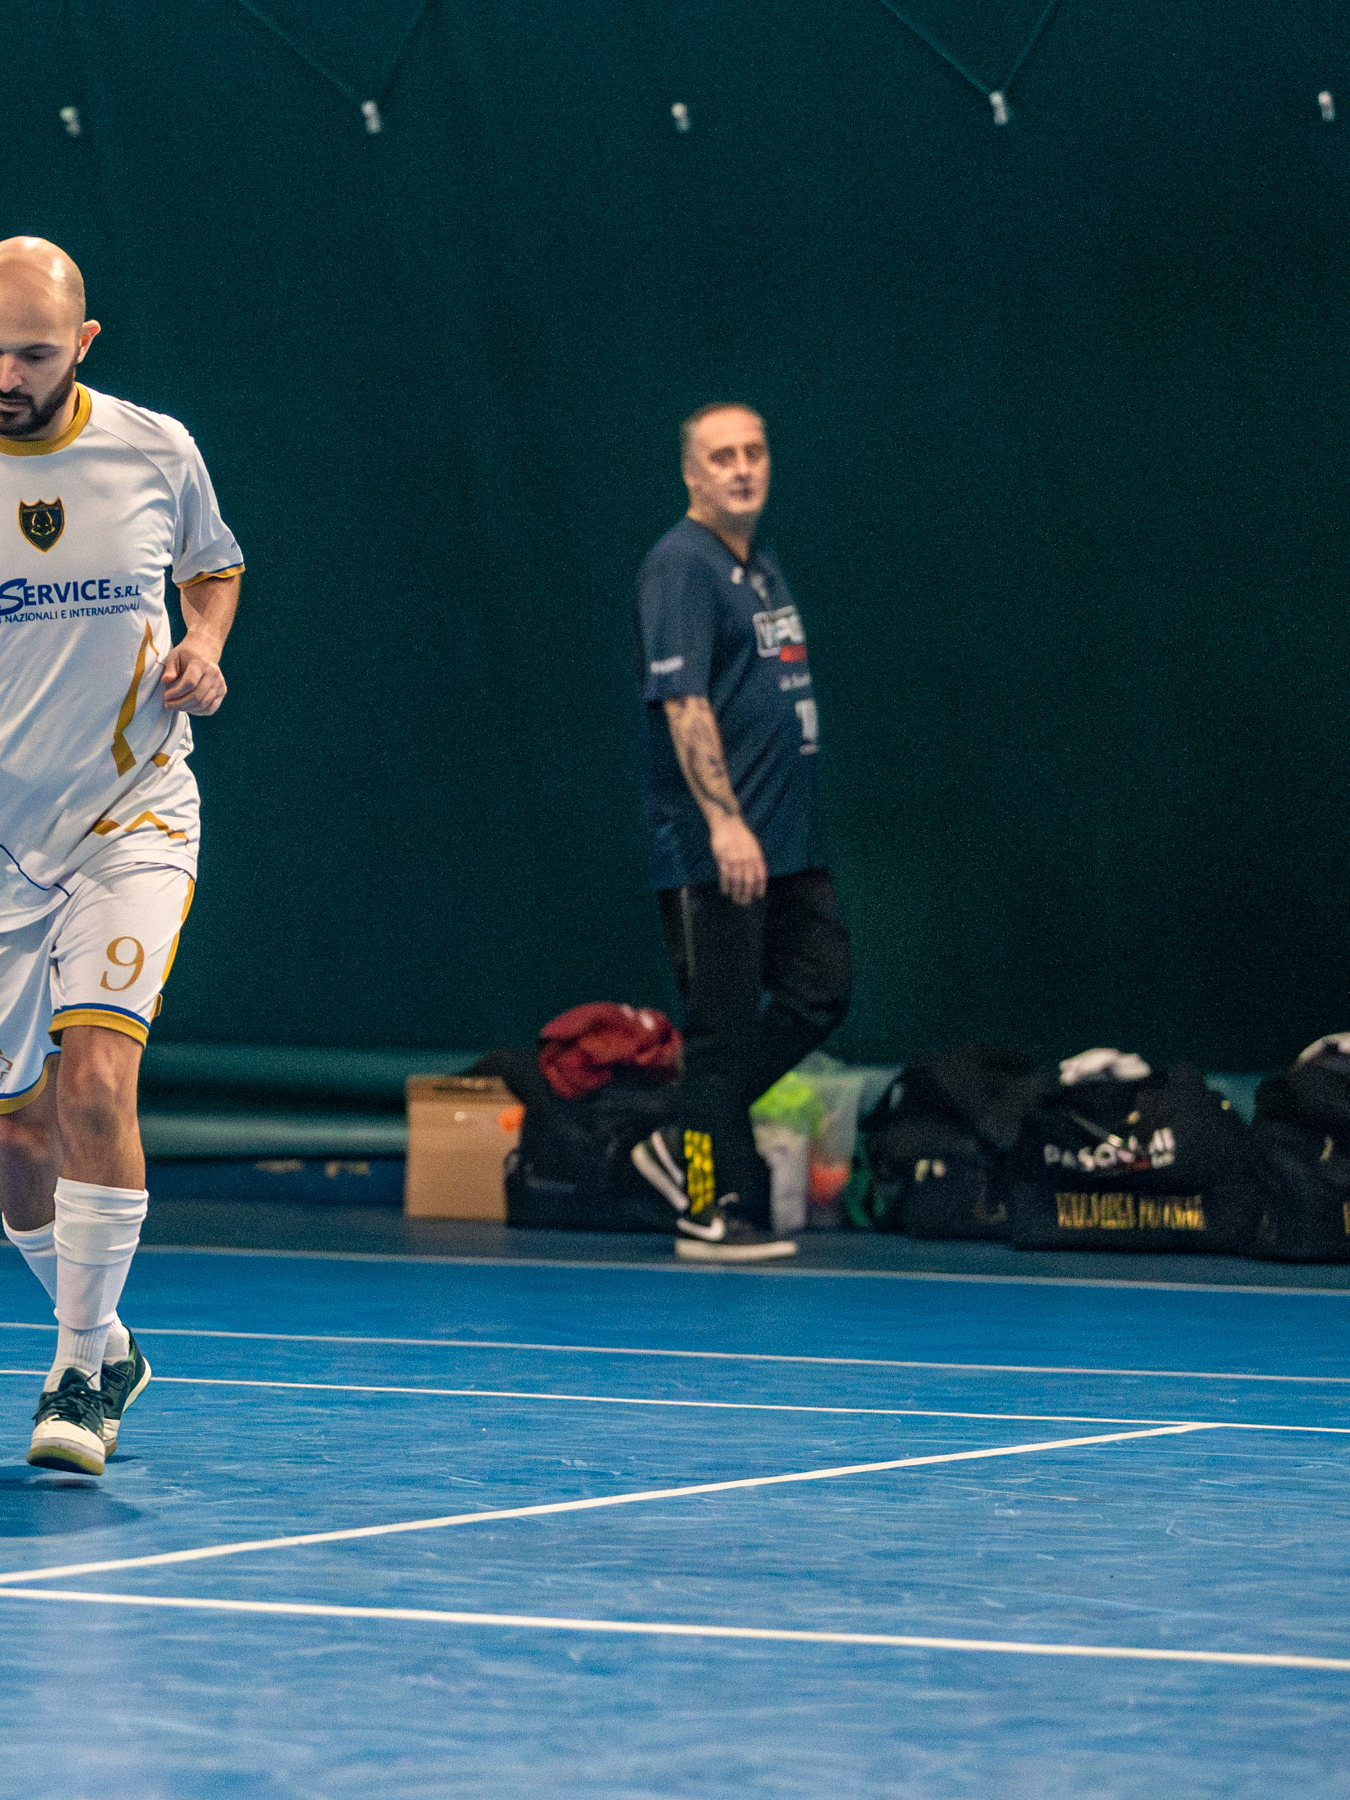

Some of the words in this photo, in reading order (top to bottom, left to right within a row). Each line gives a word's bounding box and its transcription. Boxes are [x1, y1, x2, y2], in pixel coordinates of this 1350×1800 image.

[4, 610, 58, 624] NAZIONALI
[60, 609, 67, 619] E
[99, 936, 145, 992] 9
